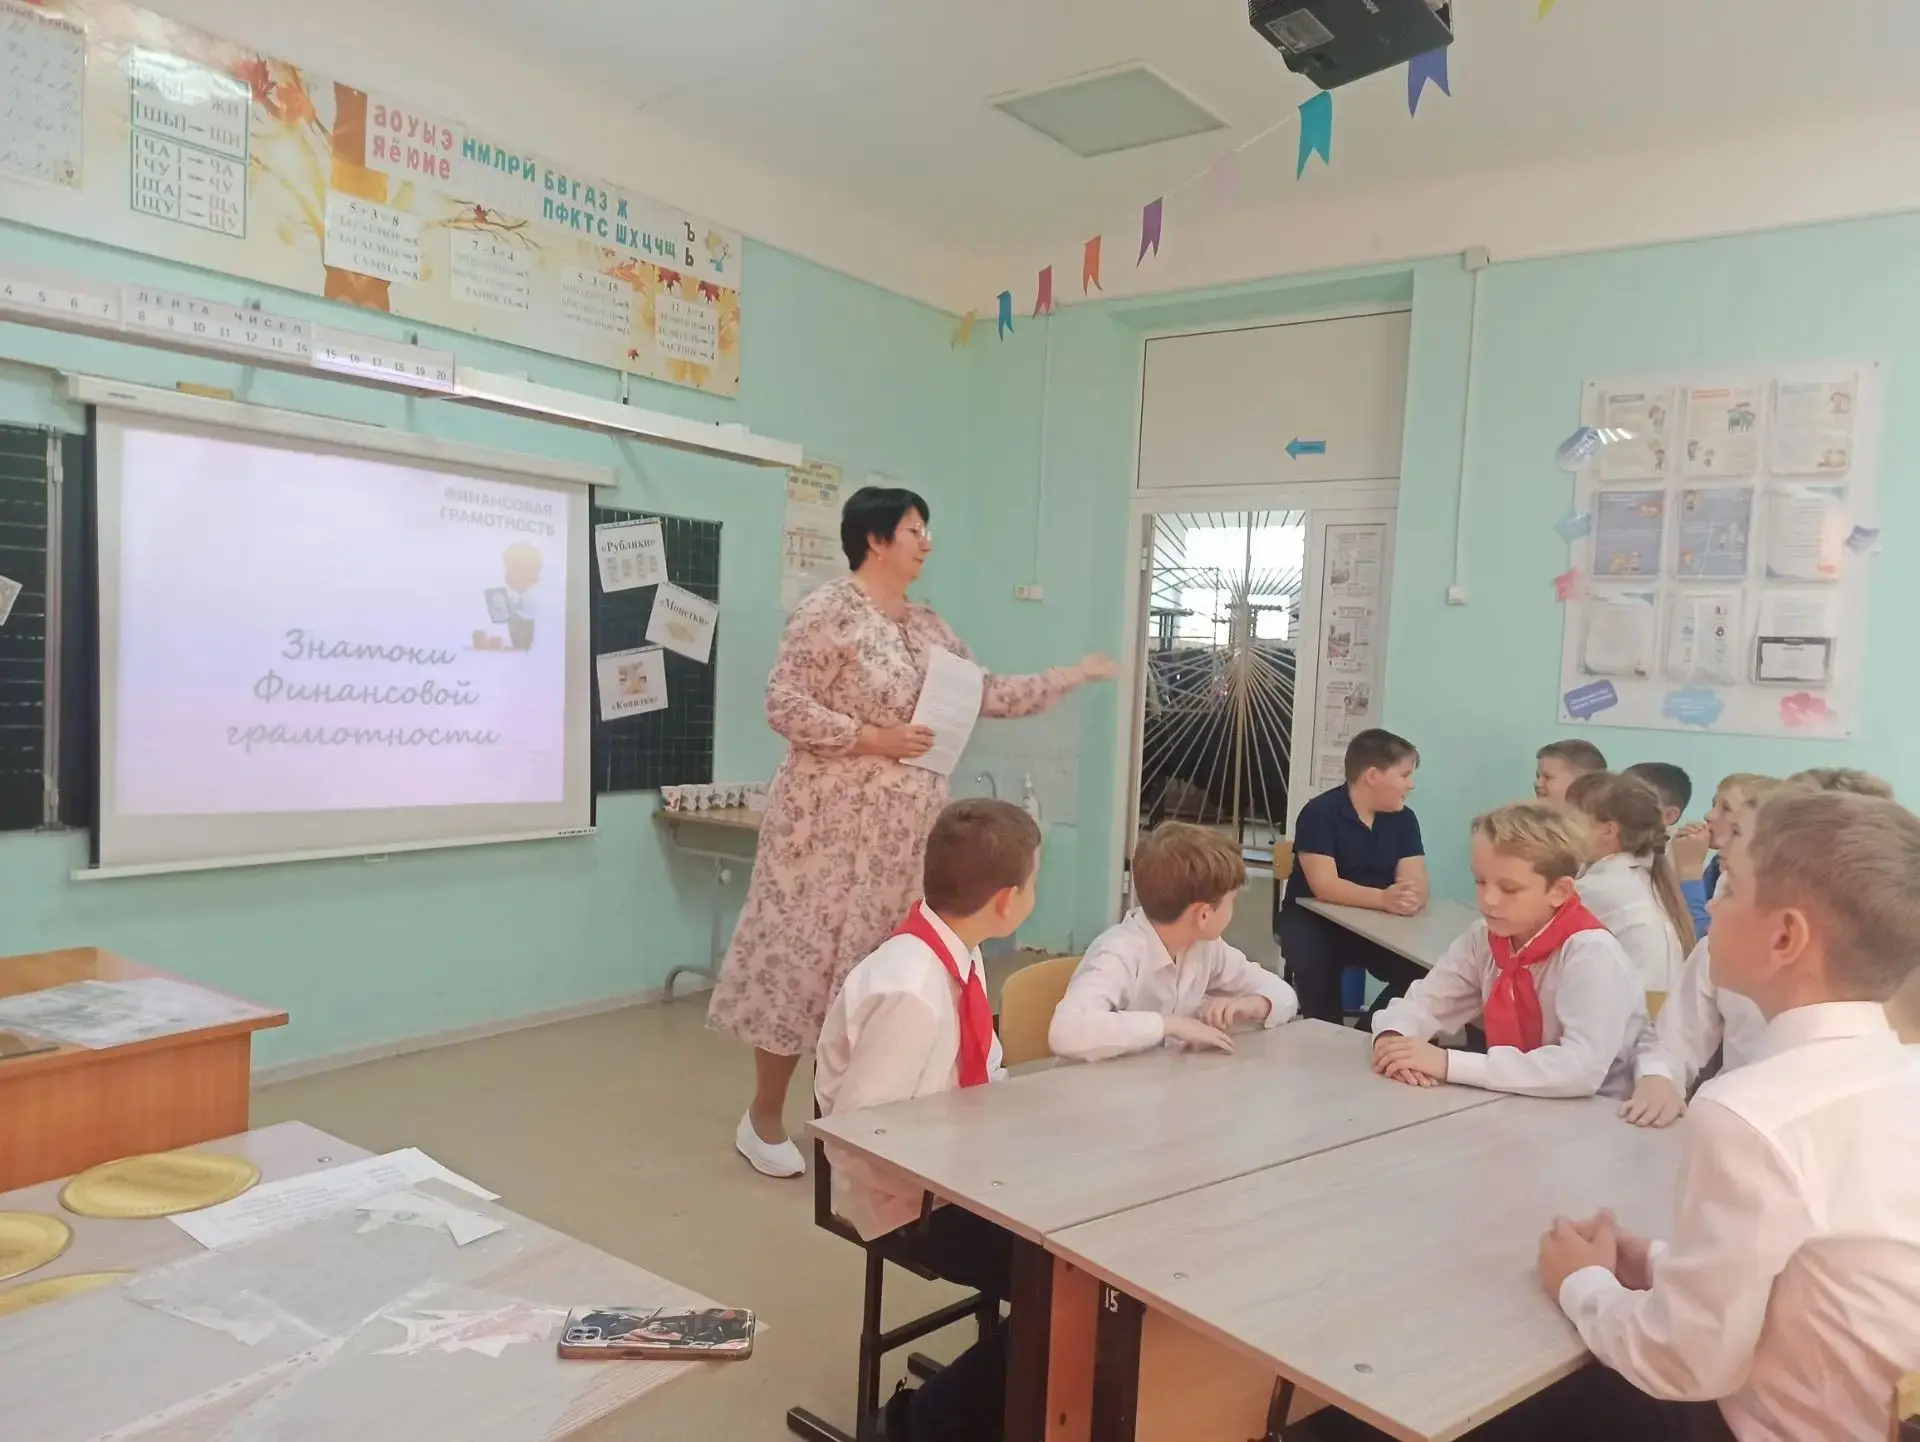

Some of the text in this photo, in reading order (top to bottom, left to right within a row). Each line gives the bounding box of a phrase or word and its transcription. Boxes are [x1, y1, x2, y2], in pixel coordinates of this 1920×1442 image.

[210, 158, 234, 178] ЧА
[209, 177, 233, 193] ЧУ
[439, 505, 556, 537] ГРАМОТНОСТЬ
[282, 628, 457, 665] Знатоки
[253, 668, 479, 706] Финансовой
[226, 723, 501, 753] грамотности
[1104, 1286, 1120, 1313] 15
